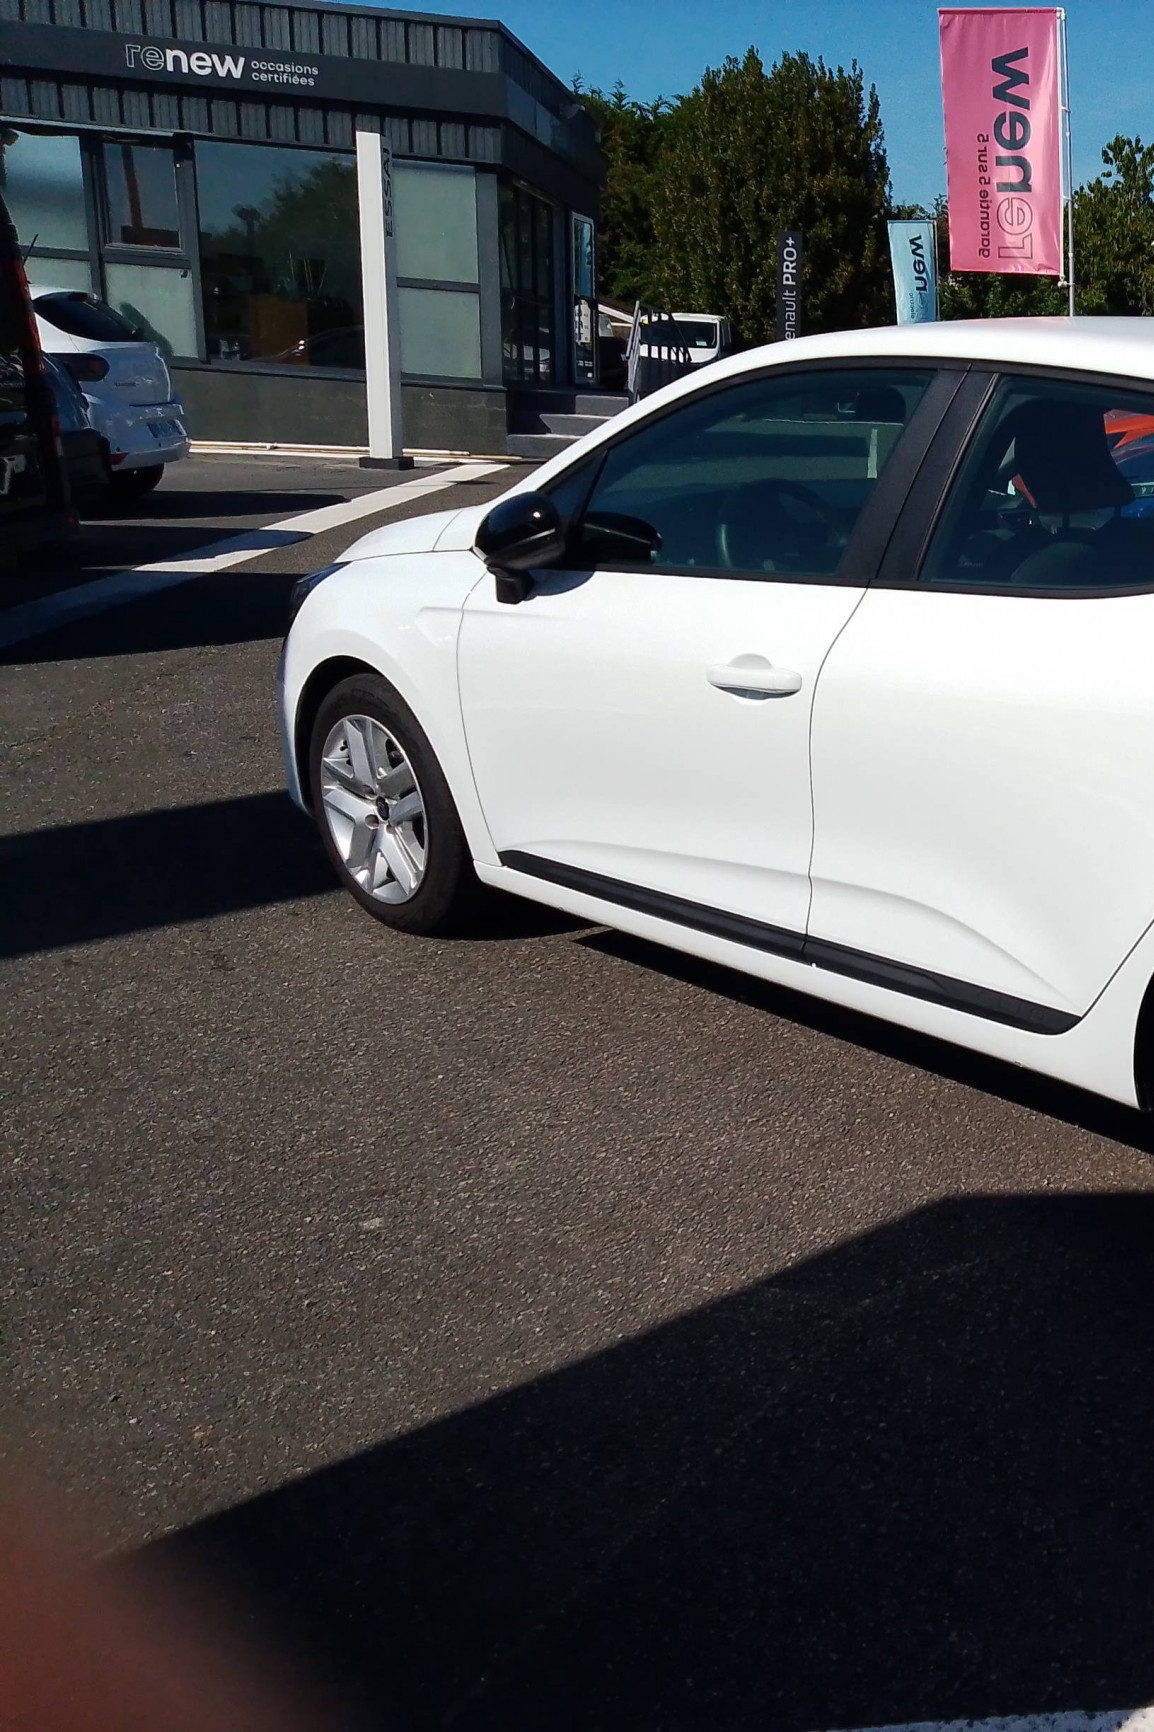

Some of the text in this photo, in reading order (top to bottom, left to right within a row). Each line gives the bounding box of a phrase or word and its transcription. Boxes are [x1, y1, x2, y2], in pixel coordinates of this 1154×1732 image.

[125, 44, 245, 79] renew
[250, 60, 319, 76] occasions
[251, 71, 315, 87] certifiées
[383, 147, 393, 237] ESSAI
[782, 236, 797, 340] enault PRO+
